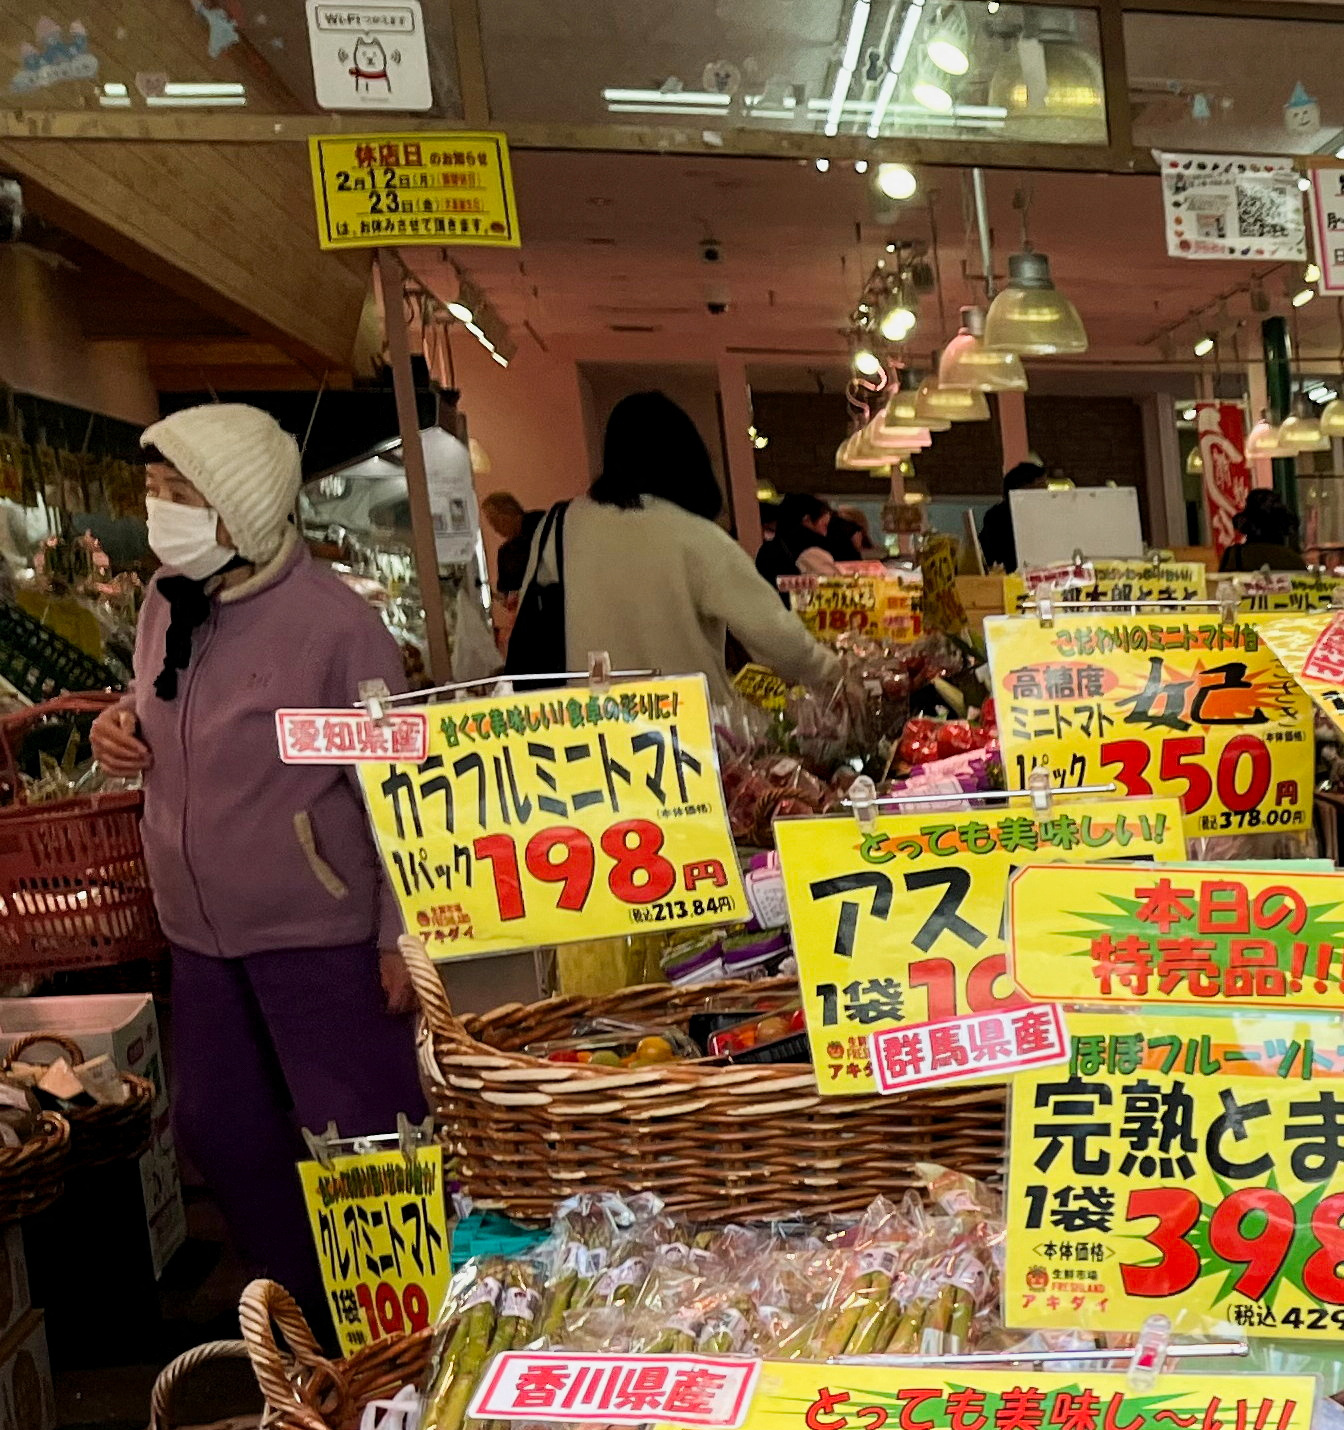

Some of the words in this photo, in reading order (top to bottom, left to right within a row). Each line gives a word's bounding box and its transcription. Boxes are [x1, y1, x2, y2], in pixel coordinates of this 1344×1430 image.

[1011, 666, 1106, 699] 高糖度
[288, 717, 424, 754] 愛知県産
[1010, 703, 1115, 740] ミニトマト
[381, 726, 702, 841] カラフルミニトマト
[1100, 734, 1272, 815] 350
[1275, 780, 1299, 807] 円
[857, 813, 1167, 864] とっても美味しい!
[393, 846, 474, 897] 1パック
[474, 818, 677, 922] 198
[682, 859, 728, 891] 円
[1133, 877, 1309, 936] 本日の
[419, 924, 474, 943] アキダイ
[816, 978, 907, 1027] 1袋
[882, 1010, 1057, 1081] 群馬県産
[1023, 1183, 1117, 1234] 1袋
[1021, 1293, 1111, 1314] アキダイ
[510, 1363, 728, 1415] 香川県産
